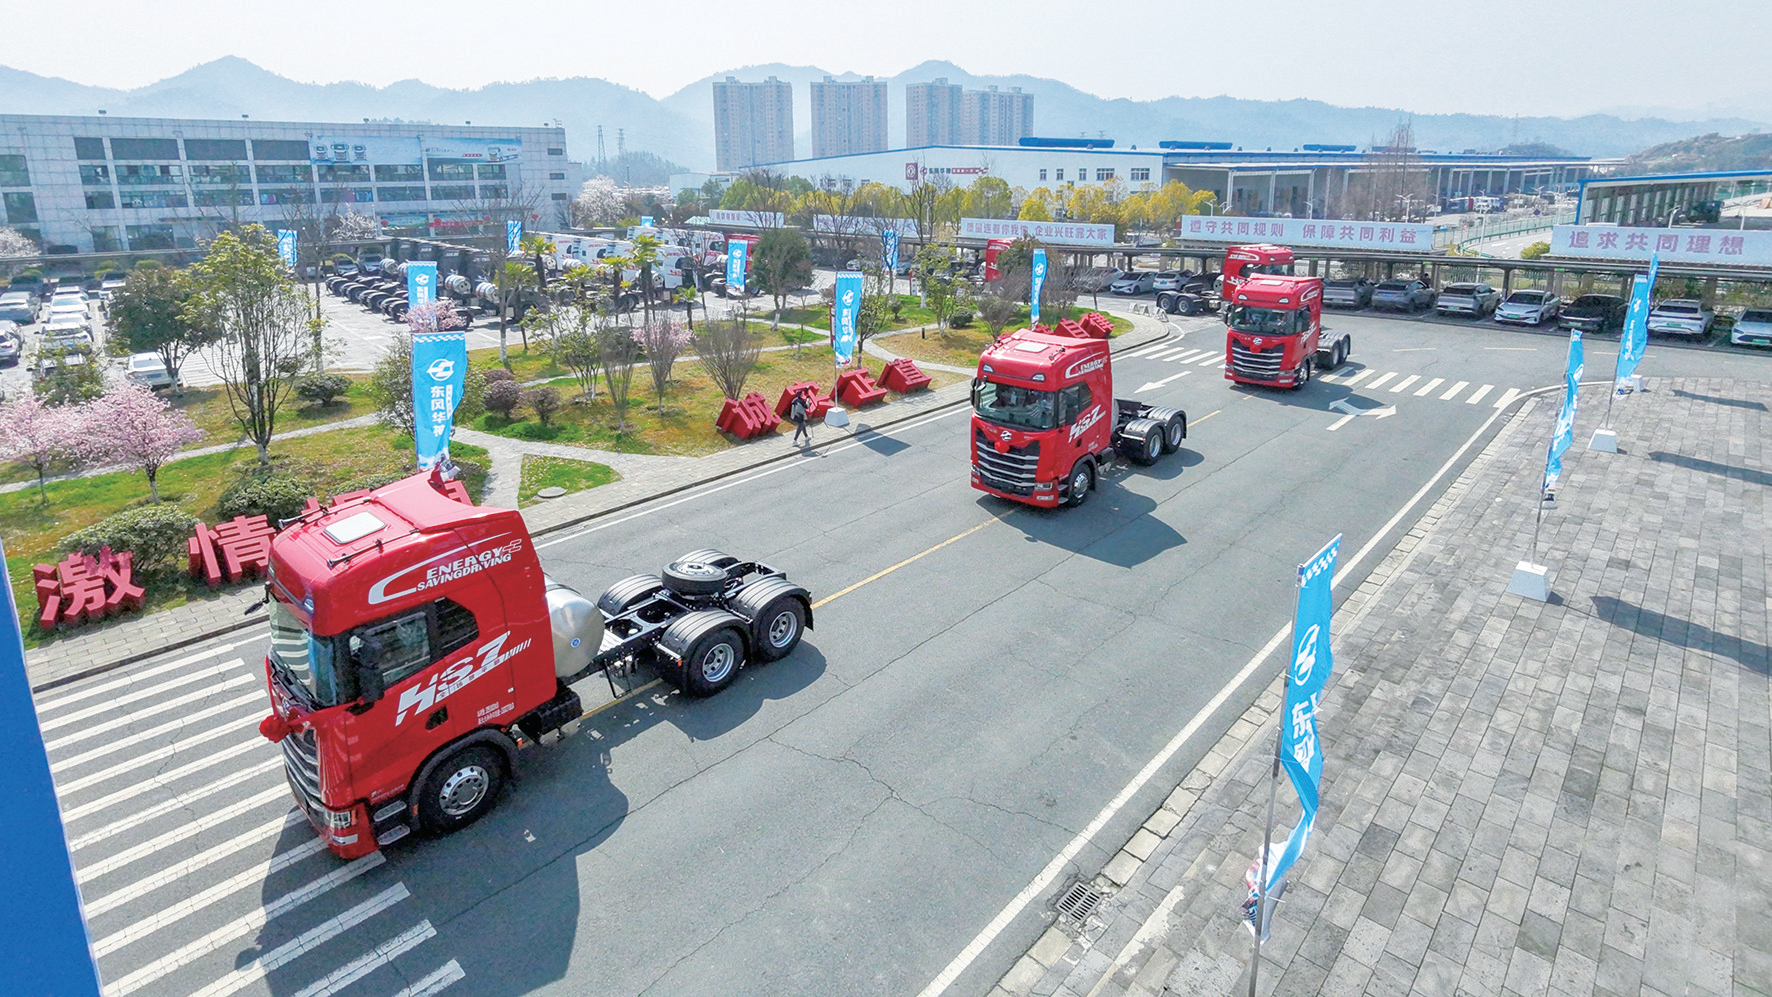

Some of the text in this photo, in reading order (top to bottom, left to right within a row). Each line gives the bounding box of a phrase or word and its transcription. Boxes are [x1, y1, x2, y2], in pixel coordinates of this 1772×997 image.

[1034, 225, 1108, 240] 企业兴旺靠大家
[1190, 219, 1417, 244] 遵守共同规则 保障共同利益
[1568, 230, 1745, 255] 追求共同理想
[426, 545, 503, 580] ENERGY
[395, 630, 511, 727] HS7
